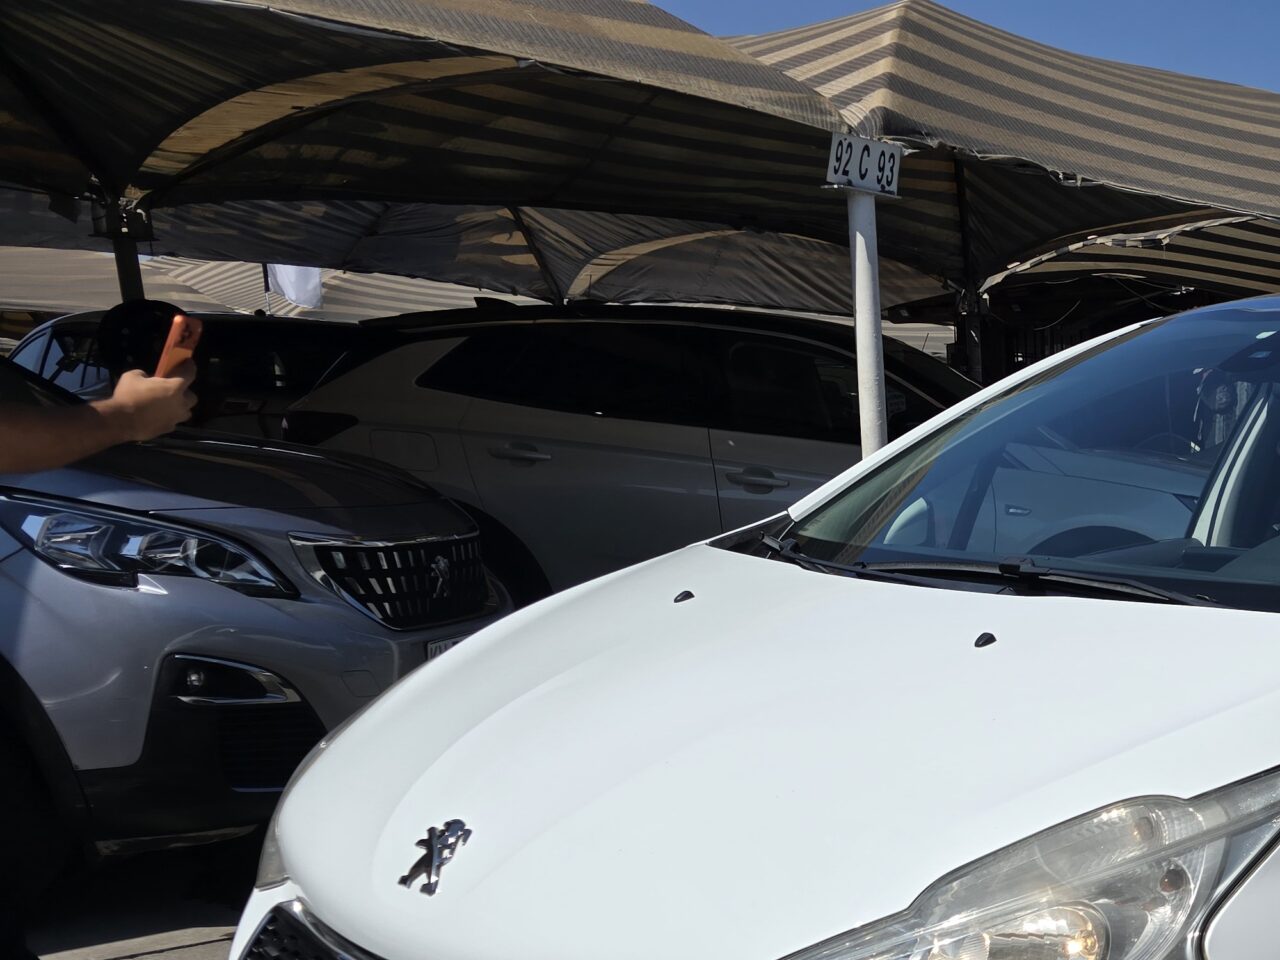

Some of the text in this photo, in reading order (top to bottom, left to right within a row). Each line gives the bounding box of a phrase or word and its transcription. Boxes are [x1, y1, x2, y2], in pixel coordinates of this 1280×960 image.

[833, 139, 895, 187] 92 C 93
